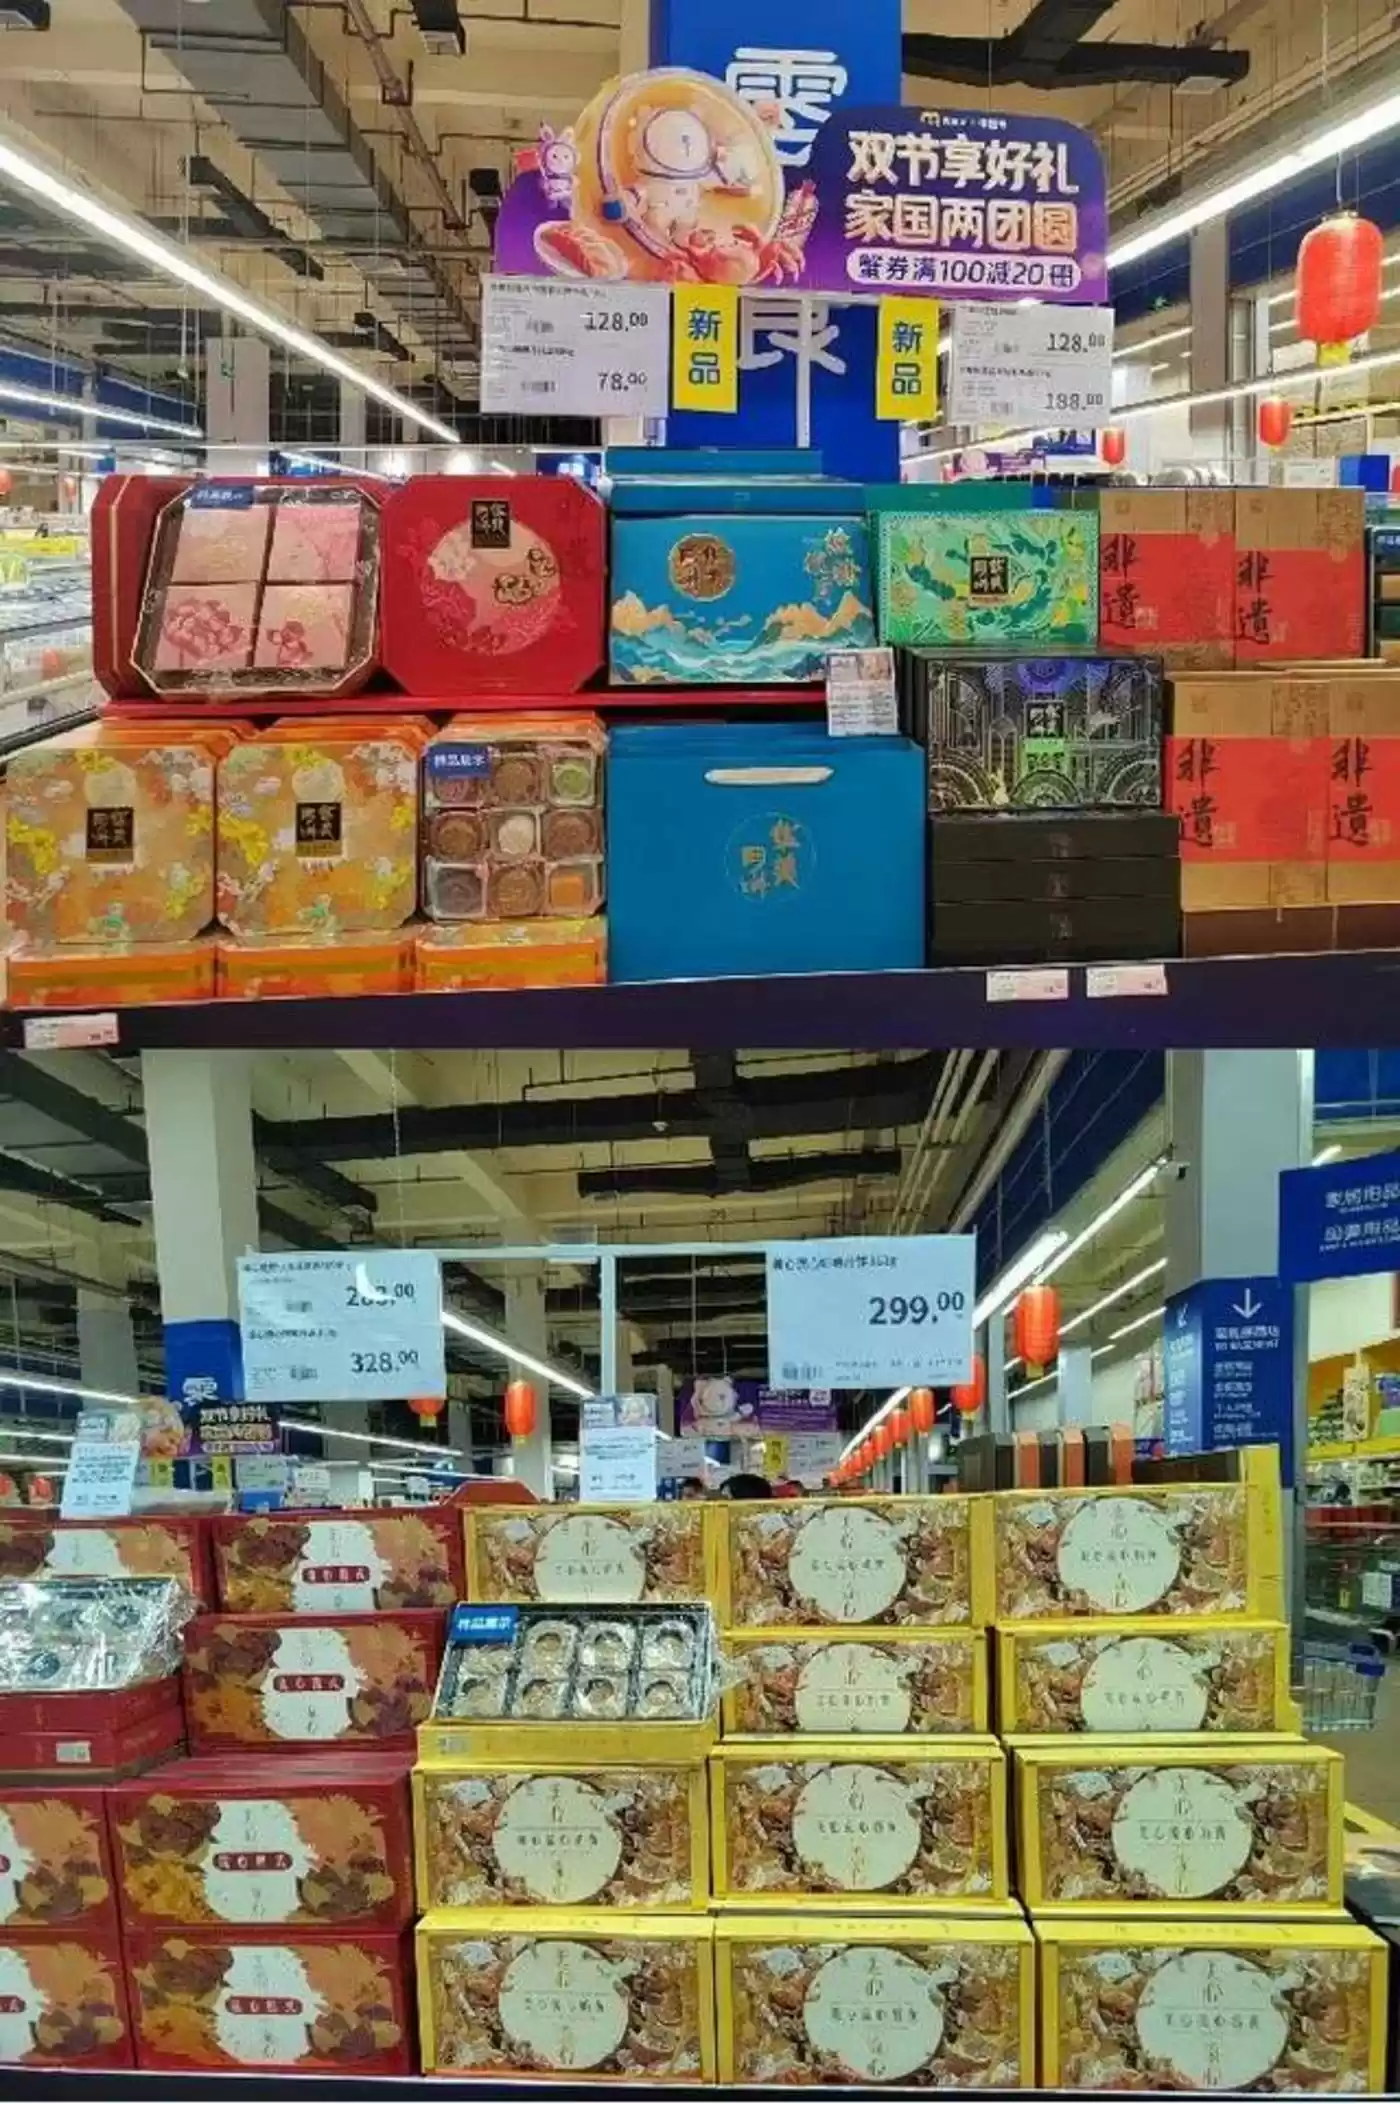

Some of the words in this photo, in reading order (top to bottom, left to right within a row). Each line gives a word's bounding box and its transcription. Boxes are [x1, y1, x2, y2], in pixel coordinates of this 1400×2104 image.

[846, 131, 1080, 194] 双节享好礼
[844, 189, 1077, 252] 家国两团圆
[584, 311, 648, 332] 128.00
[687, 307, 723, 386] 新品
[891, 321, 924, 395] 新品
[1047, 331, 1106, 353] 128.00
[598, 371, 648, 392] 78.00
[869, 1291, 965, 1326] 299.00
[350, 1350, 419, 1373] 328.00
